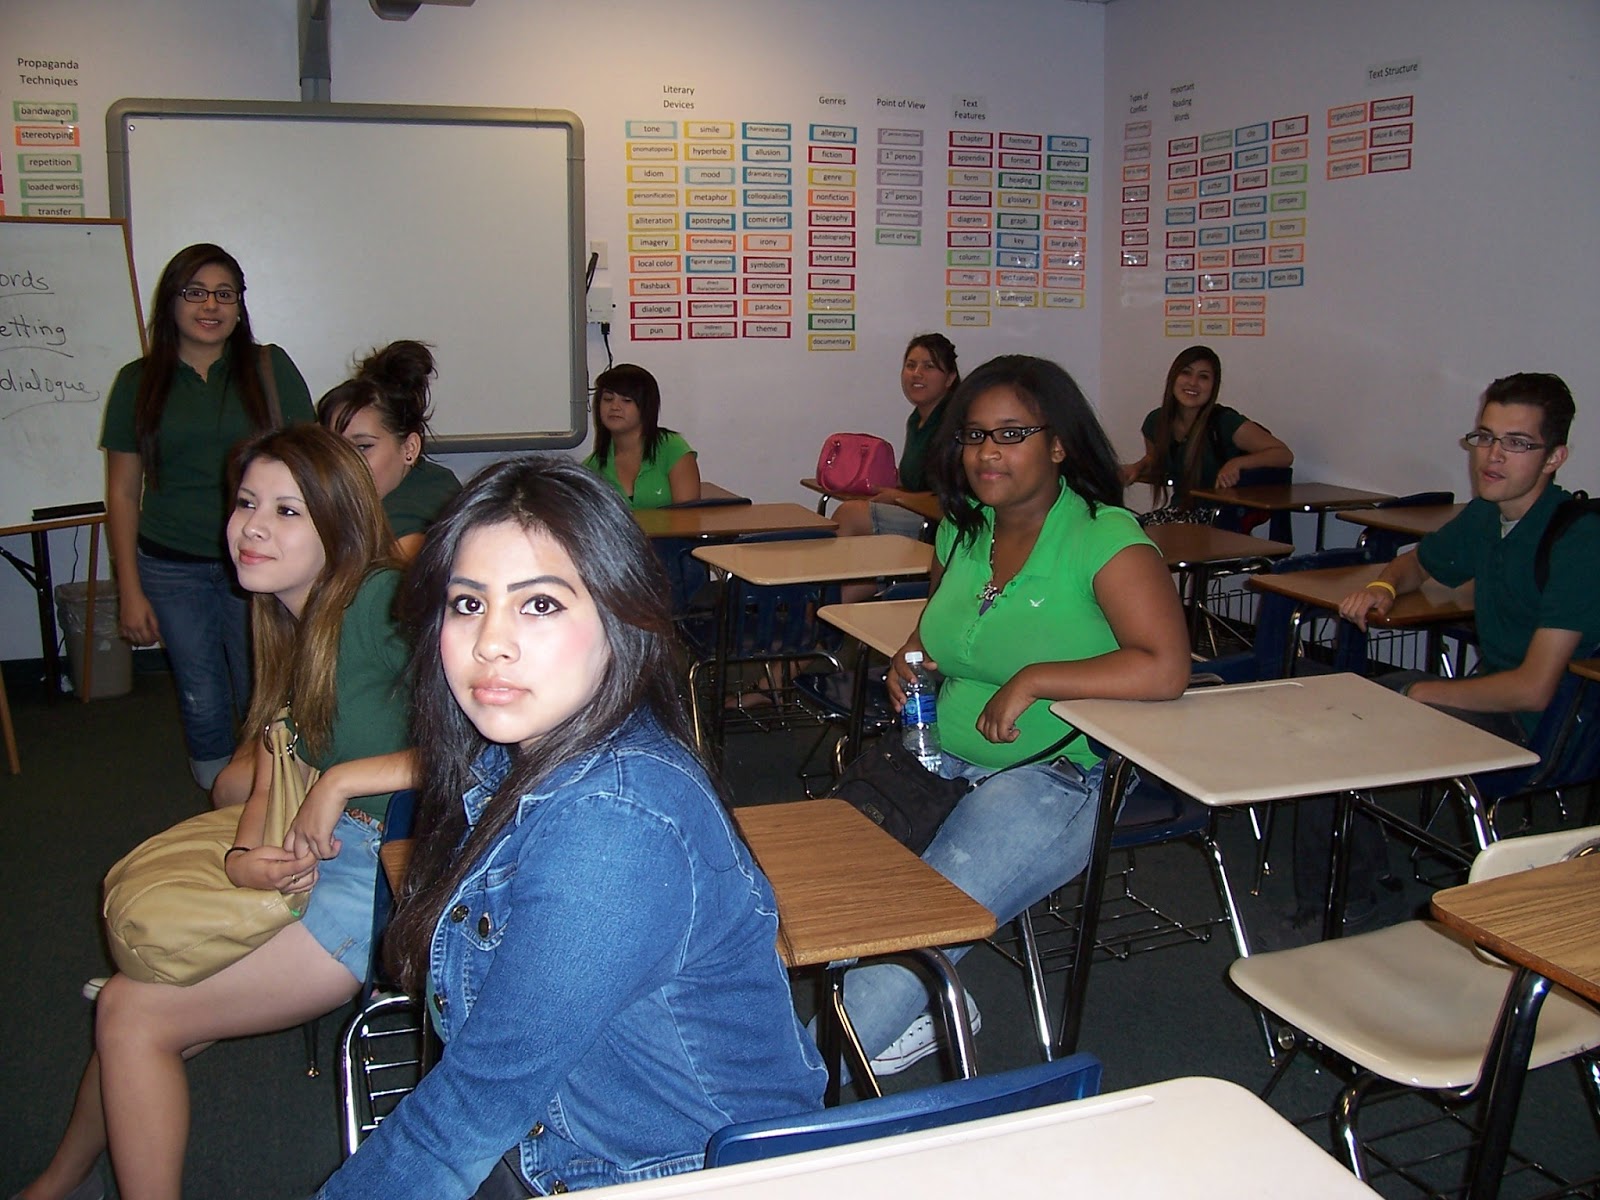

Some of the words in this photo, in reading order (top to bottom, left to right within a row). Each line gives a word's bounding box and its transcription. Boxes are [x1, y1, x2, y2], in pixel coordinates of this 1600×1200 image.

[17, 57, 79, 70] Propaganda
[1369, 69, 1384, 80] Text
[1384, 63, 1419, 77] Structure
[19, 74, 79, 87] Techniques
[663, 85, 695, 96] Literary
[663, 100, 695, 110] Devices
[819, 96, 846, 106] Genres
[877, 98, 896, 107] Point
[898, 100, 906, 108] of
[907, 101, 926, 110] View
[962, 99, 978, 108] Text
[21, 107, 71, 117] bandwagon
[954, 111, 986, 120] Features
[21, 130, 74, 141] stereotyping
[820, 129, 847, 138] allegory
[692, 148, 727, 156] hyperbole
[29, 159, 72, 168] repetition
[823, 174, 842, 182] genre
[28, 183, 54, 191] loaded
[55, 183, 79, 191] words
[694, 194, 728, 202] metaphor
[747, 193, 788, 202] colloquialism
[959, 194, 982, 202] caption
[38, 208, 72, 216] transfer
[635, 217, 673, 225] alliteration
[691, 217, 730, 226] apostrophe
[816, 214, 848, 223] biography
[957, 216, 982, 224] diagram
[640, 238, 668, 247] imagery
[759, 238, 777, 247] irony
[638, 259, 655, 267] local
[655, 259, 673, 267] color
[834, 255, 850, 263] story
[750, 261, 786, 270] symbolism
[640, 282, 671, 290] flashback
[641, 305, 672, 314] dialogue
[755, 304, 782, 312] paradox
[817, 317, 848, 325] expository
[649, 327, 664, 335] pun
[0, 369, 94, 401] dialogue
